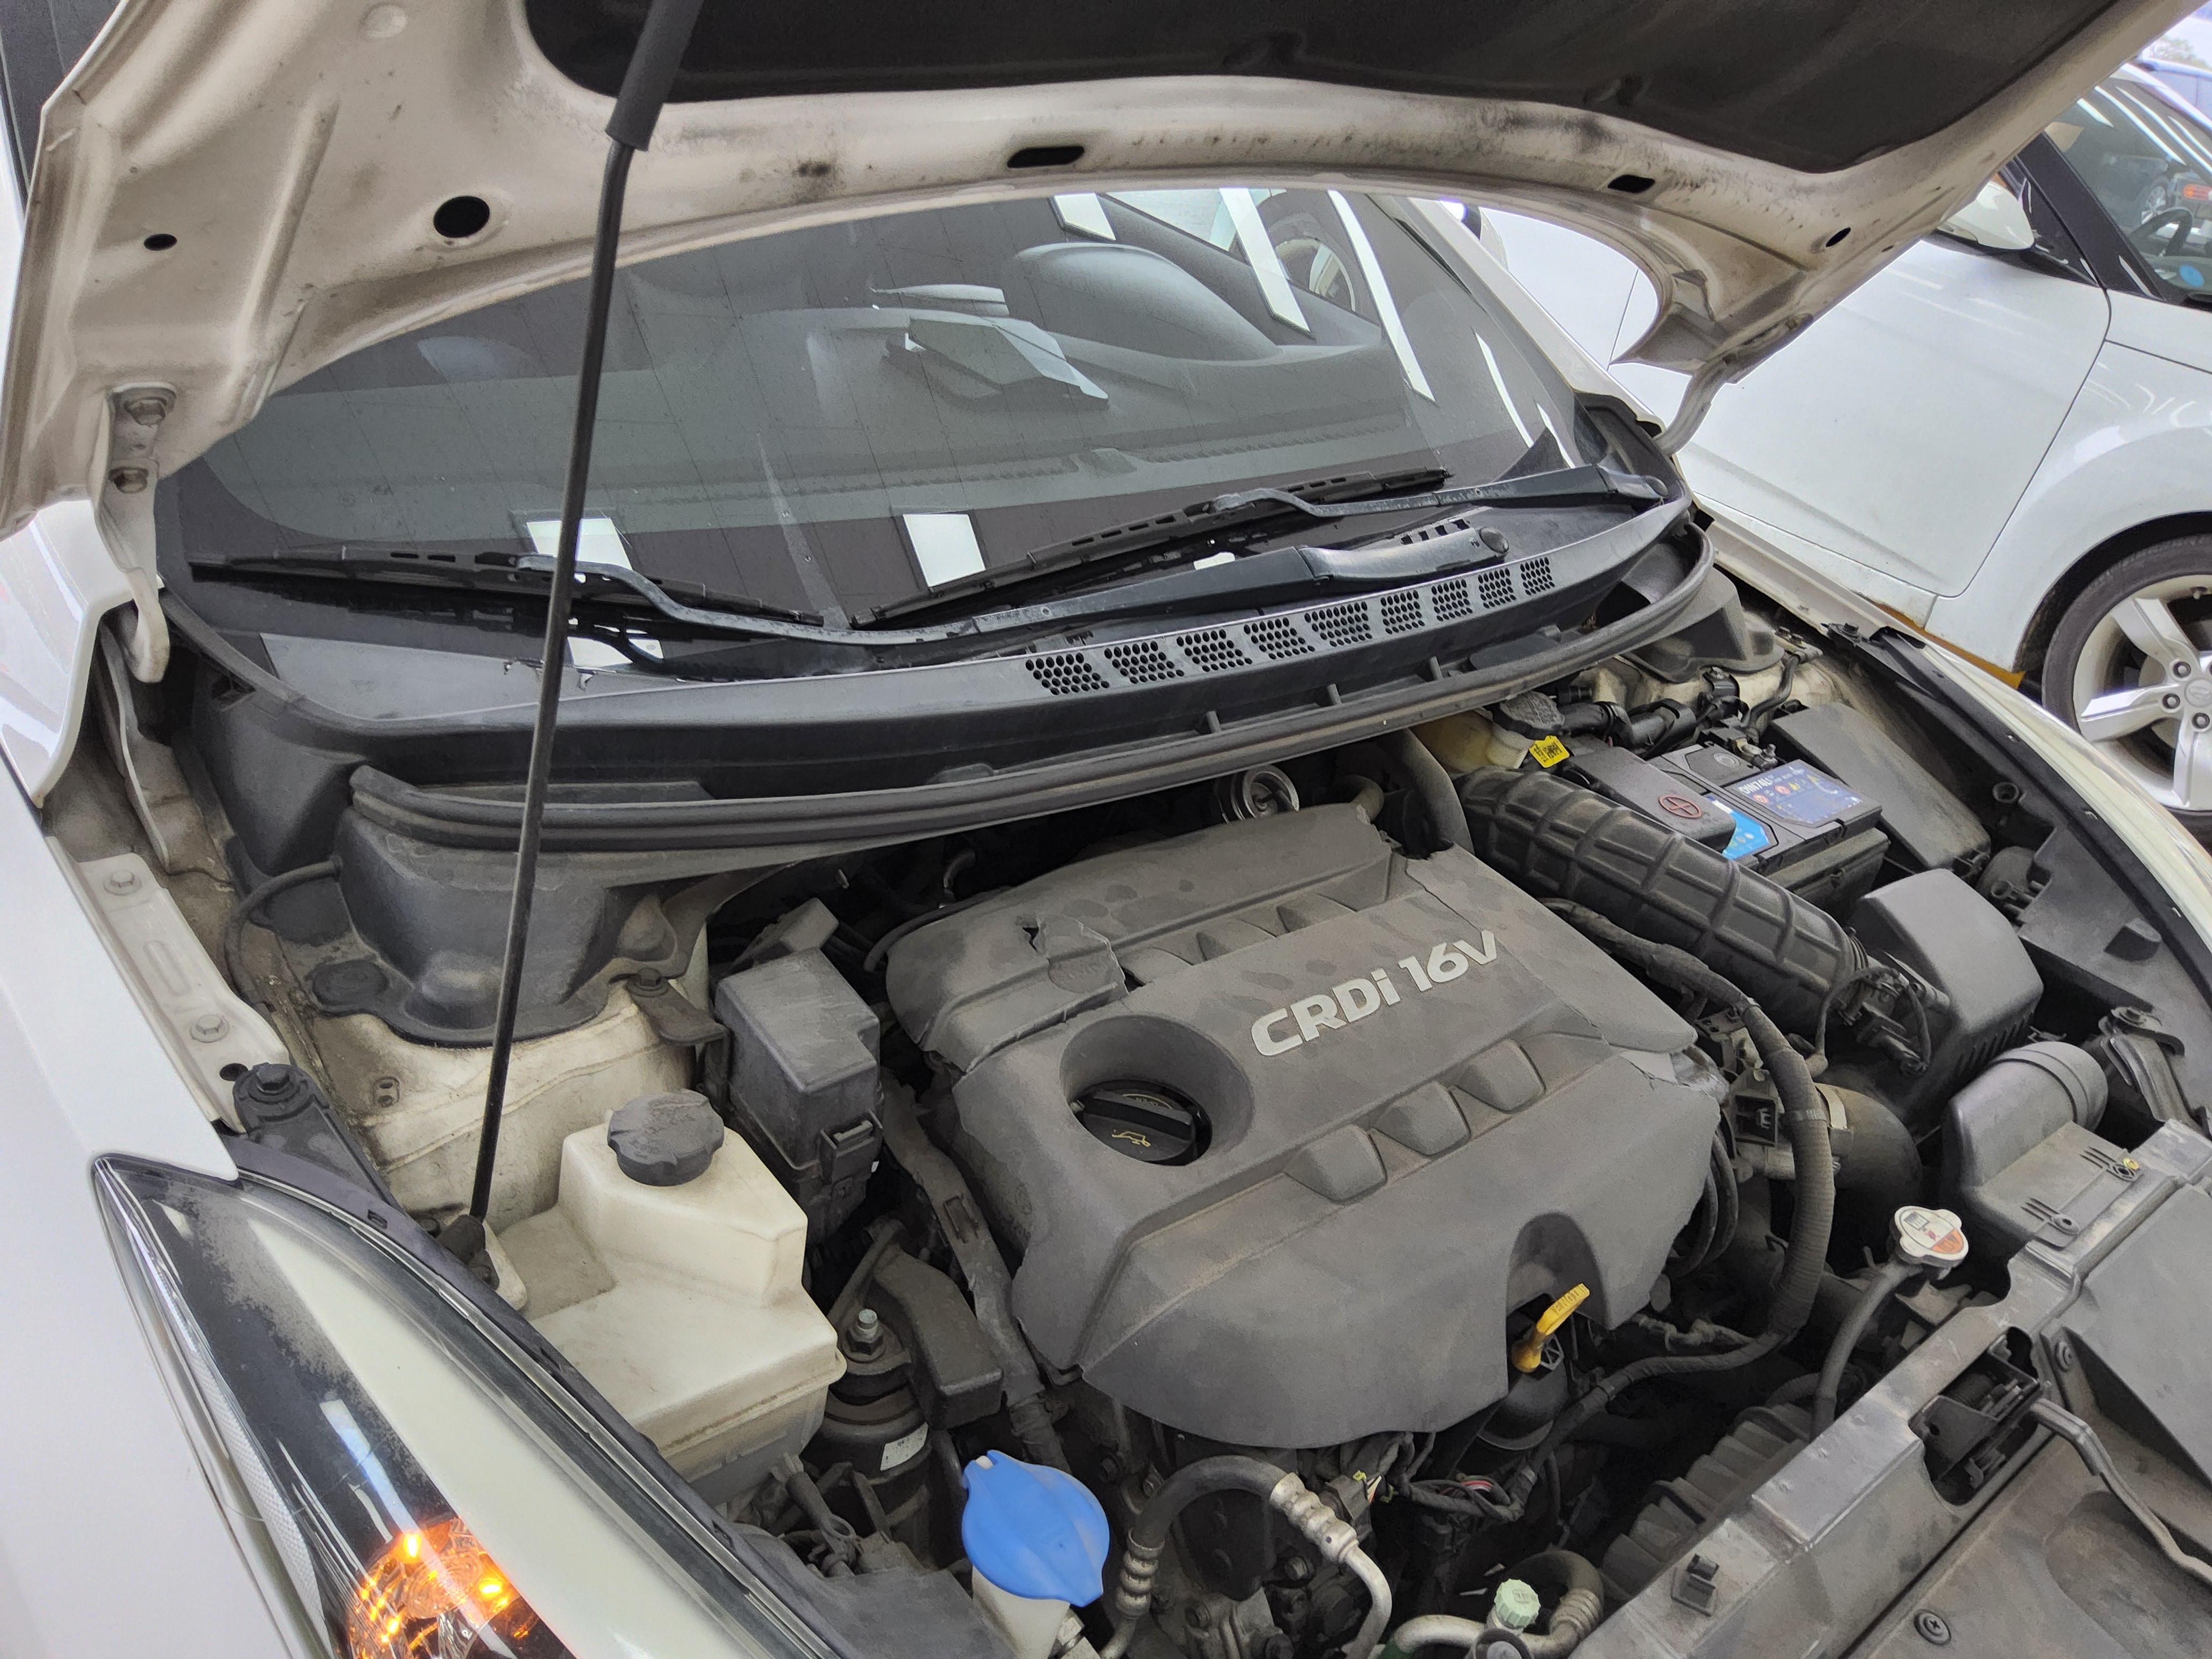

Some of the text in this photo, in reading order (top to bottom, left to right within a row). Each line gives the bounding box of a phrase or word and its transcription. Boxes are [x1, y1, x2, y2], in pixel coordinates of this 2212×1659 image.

[1251, 929, 1497, 1056] CRDi 16V
[1552, 1282, 1589, 1317] ENGINE
